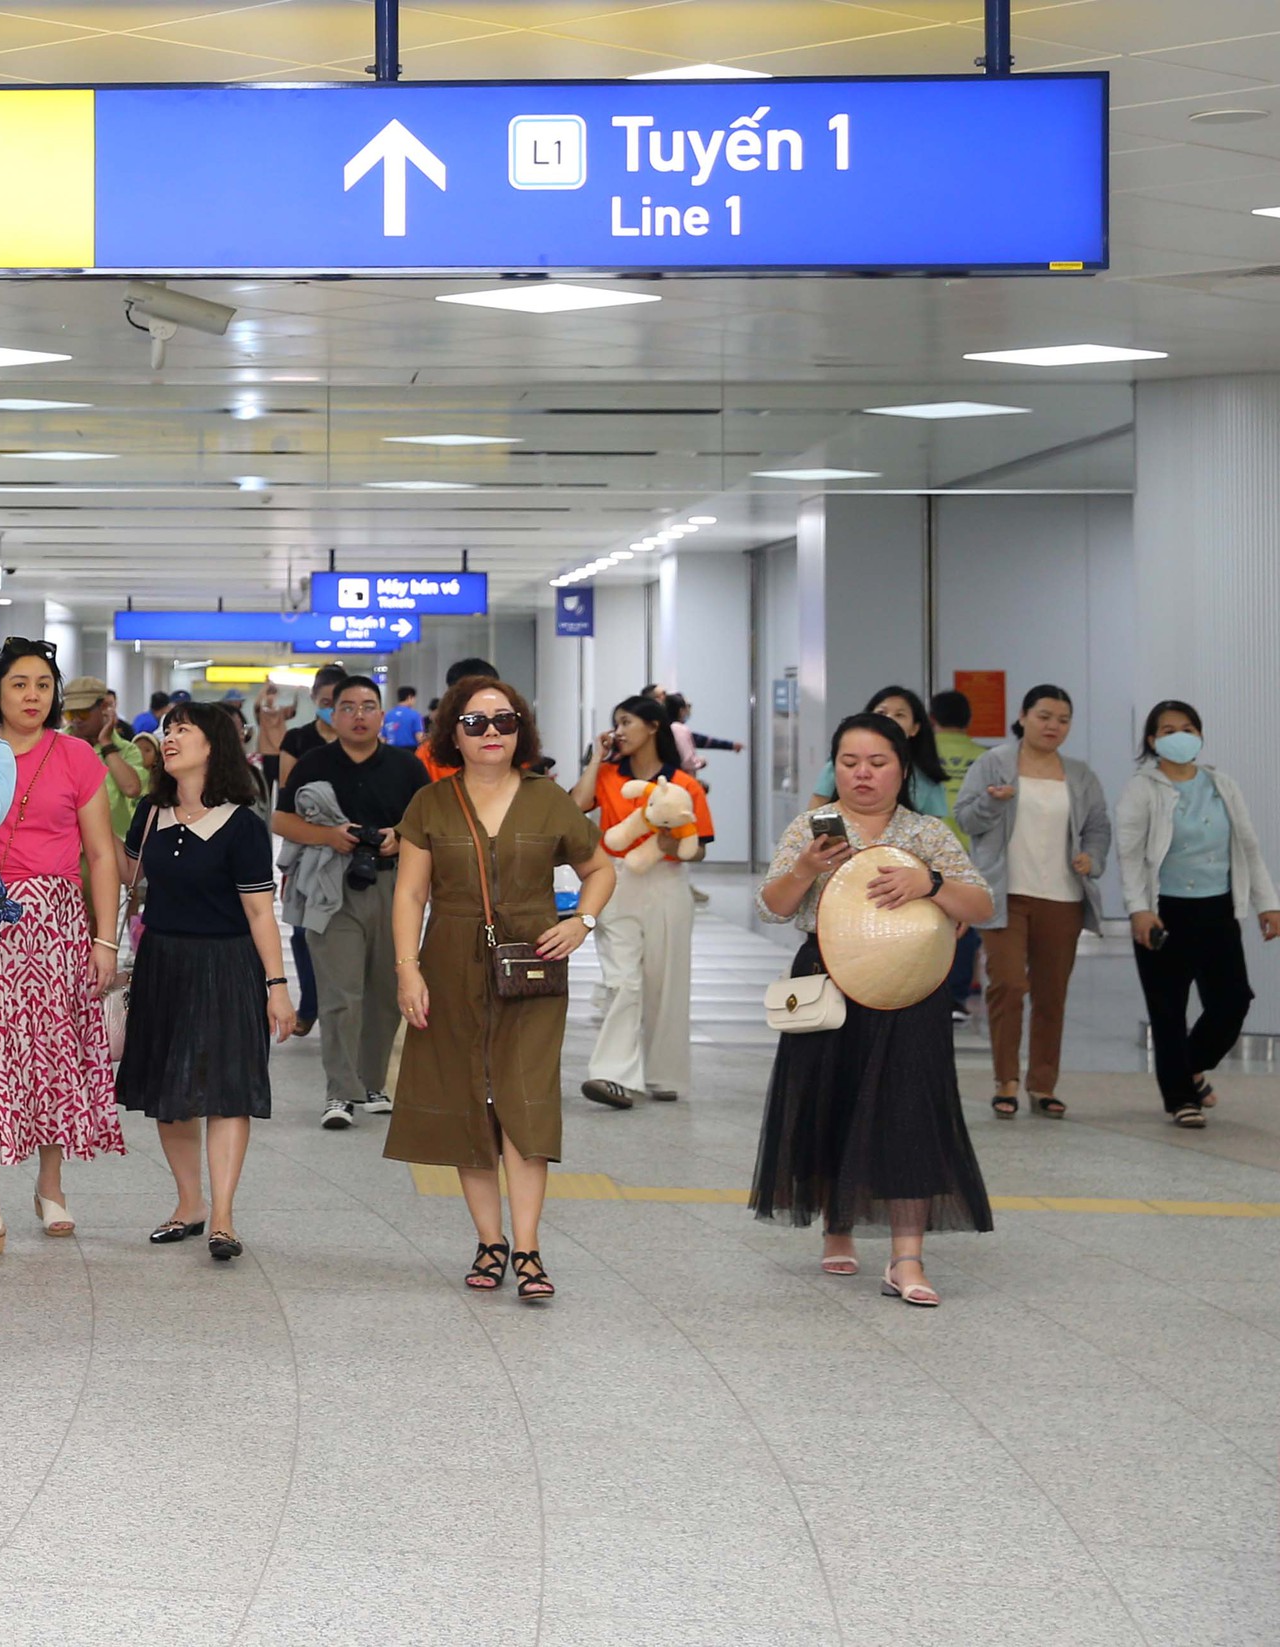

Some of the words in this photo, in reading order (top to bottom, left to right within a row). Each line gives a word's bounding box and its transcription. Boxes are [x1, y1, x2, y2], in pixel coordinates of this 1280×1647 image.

[533, 140, 561, 165] L1
[611, 106, 803, 187] Tuyến
[828, 113, 849, 170] 1
[611, 196, 710, 236] Line
[725, 195, 741, 236] 1
